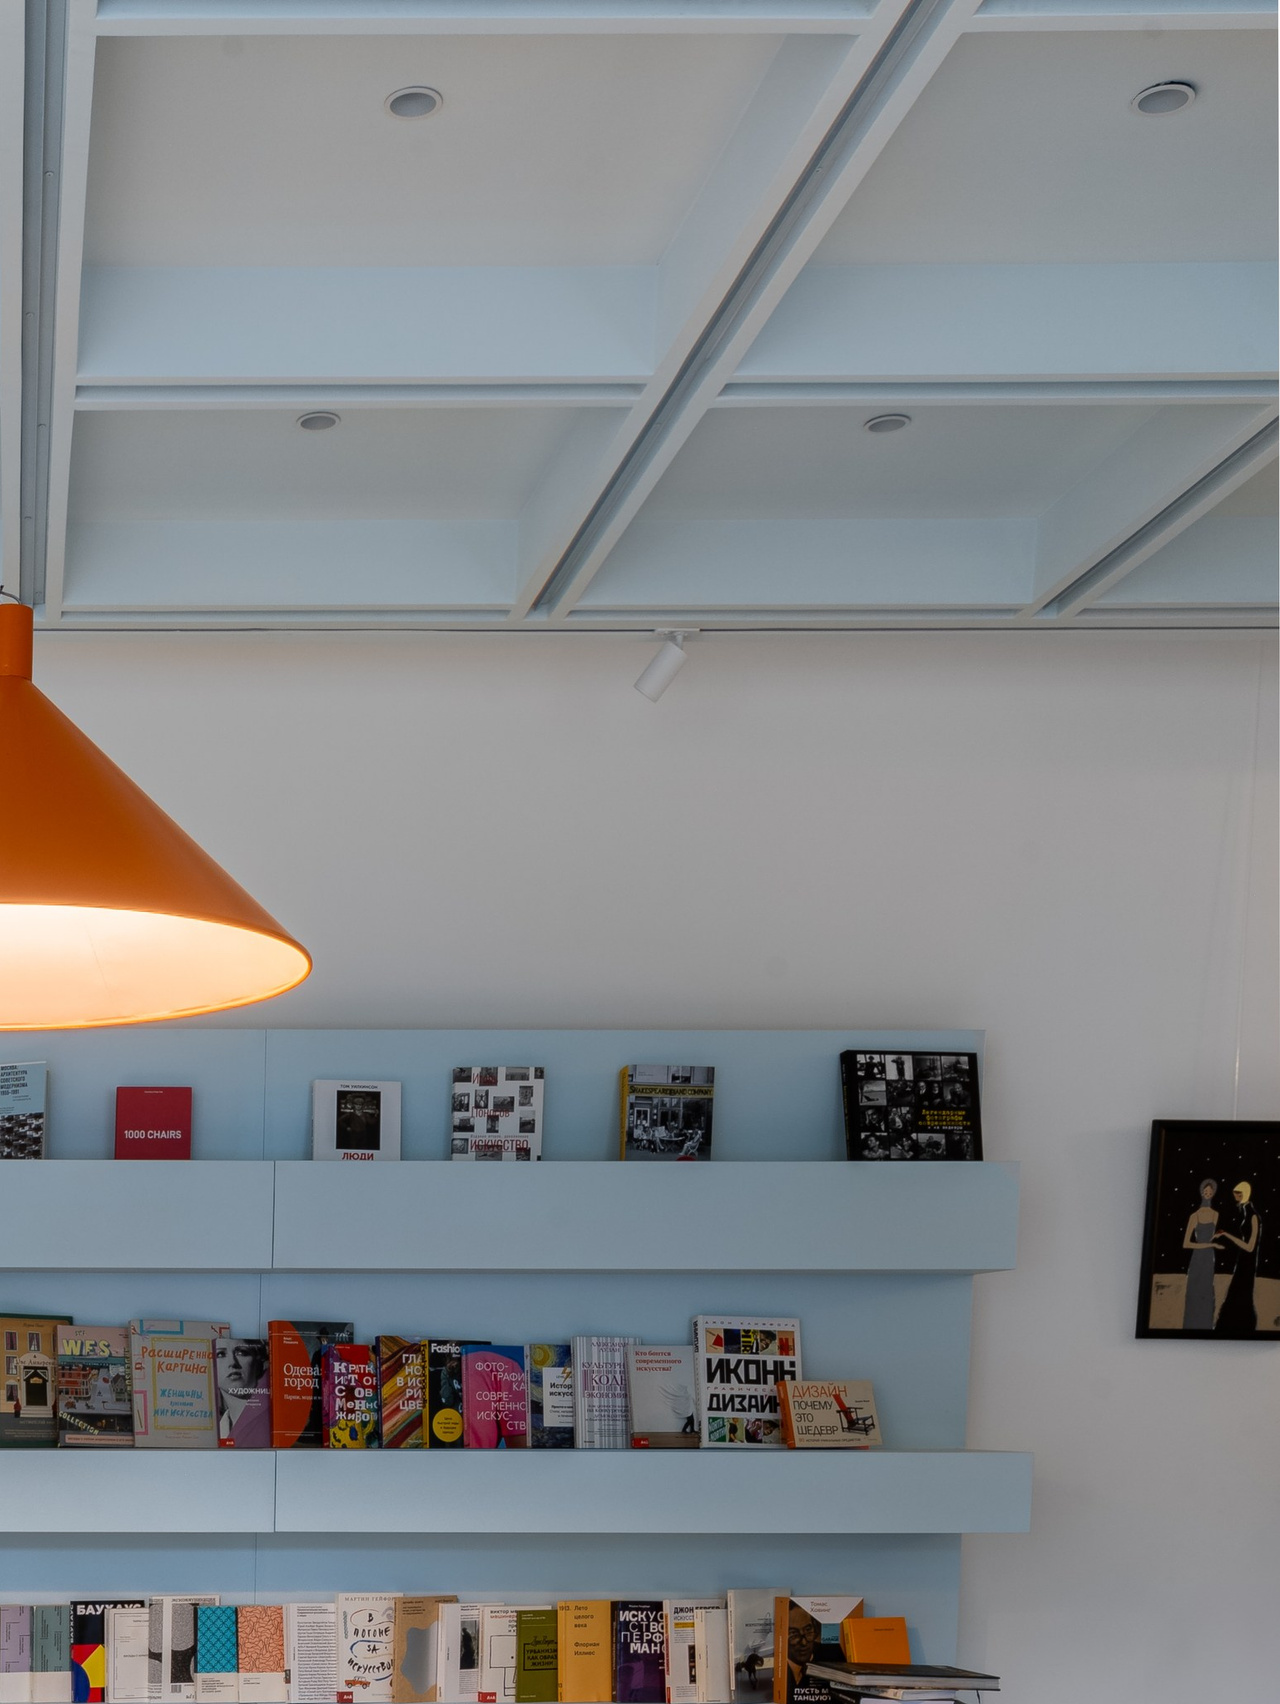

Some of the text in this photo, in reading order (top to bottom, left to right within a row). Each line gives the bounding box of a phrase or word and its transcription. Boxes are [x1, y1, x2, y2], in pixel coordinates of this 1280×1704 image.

[629, 1085, 669, 1096] SHAKESPEARE
[688, 1086, 712, 1096] COMPANY
[124, 1130, 182, 1140] 1000 CHAIRS
[470, 1138, 528, 1152] ИСКУССТВО
[342, 1152, 374, 1161] ЛЮДИ
[62, 1339, 112, 1358] WES
[157, 1360, 208, 1374] Картина
[283, 1362, 322, 1376] Одева
[475, 1362, 508, 1371] ФОТО-
[706, 1358, 796, 1386] ИКОНЫ
[284, 1378, 319, 1390] город
[396, 1377, 404, 1386] В
[792, 1382, 847, 1399] ДИЗАЙН
[476, 1392, 512, 1400] СОВРЕ-
[793, 1400, 833, 1410] ПОЧЕМУ
[477, 1411, 512, 1420] ИСКУС-
[795, 1413, 814, 1422] ЭТО
[59, 1411, 100, 1436] COLLECTION
[797, 1426, 838, 1436] ШЕДЕВР
[673, 1607, 694, 1616] ДЖОН
[368, 1613, 374, 1622] В
[574, 1614, 594, 1622] целого
[354, 1626, 390, 1638] ПОГОНЕ
[574, 1642, 600, 1650] Флориан
